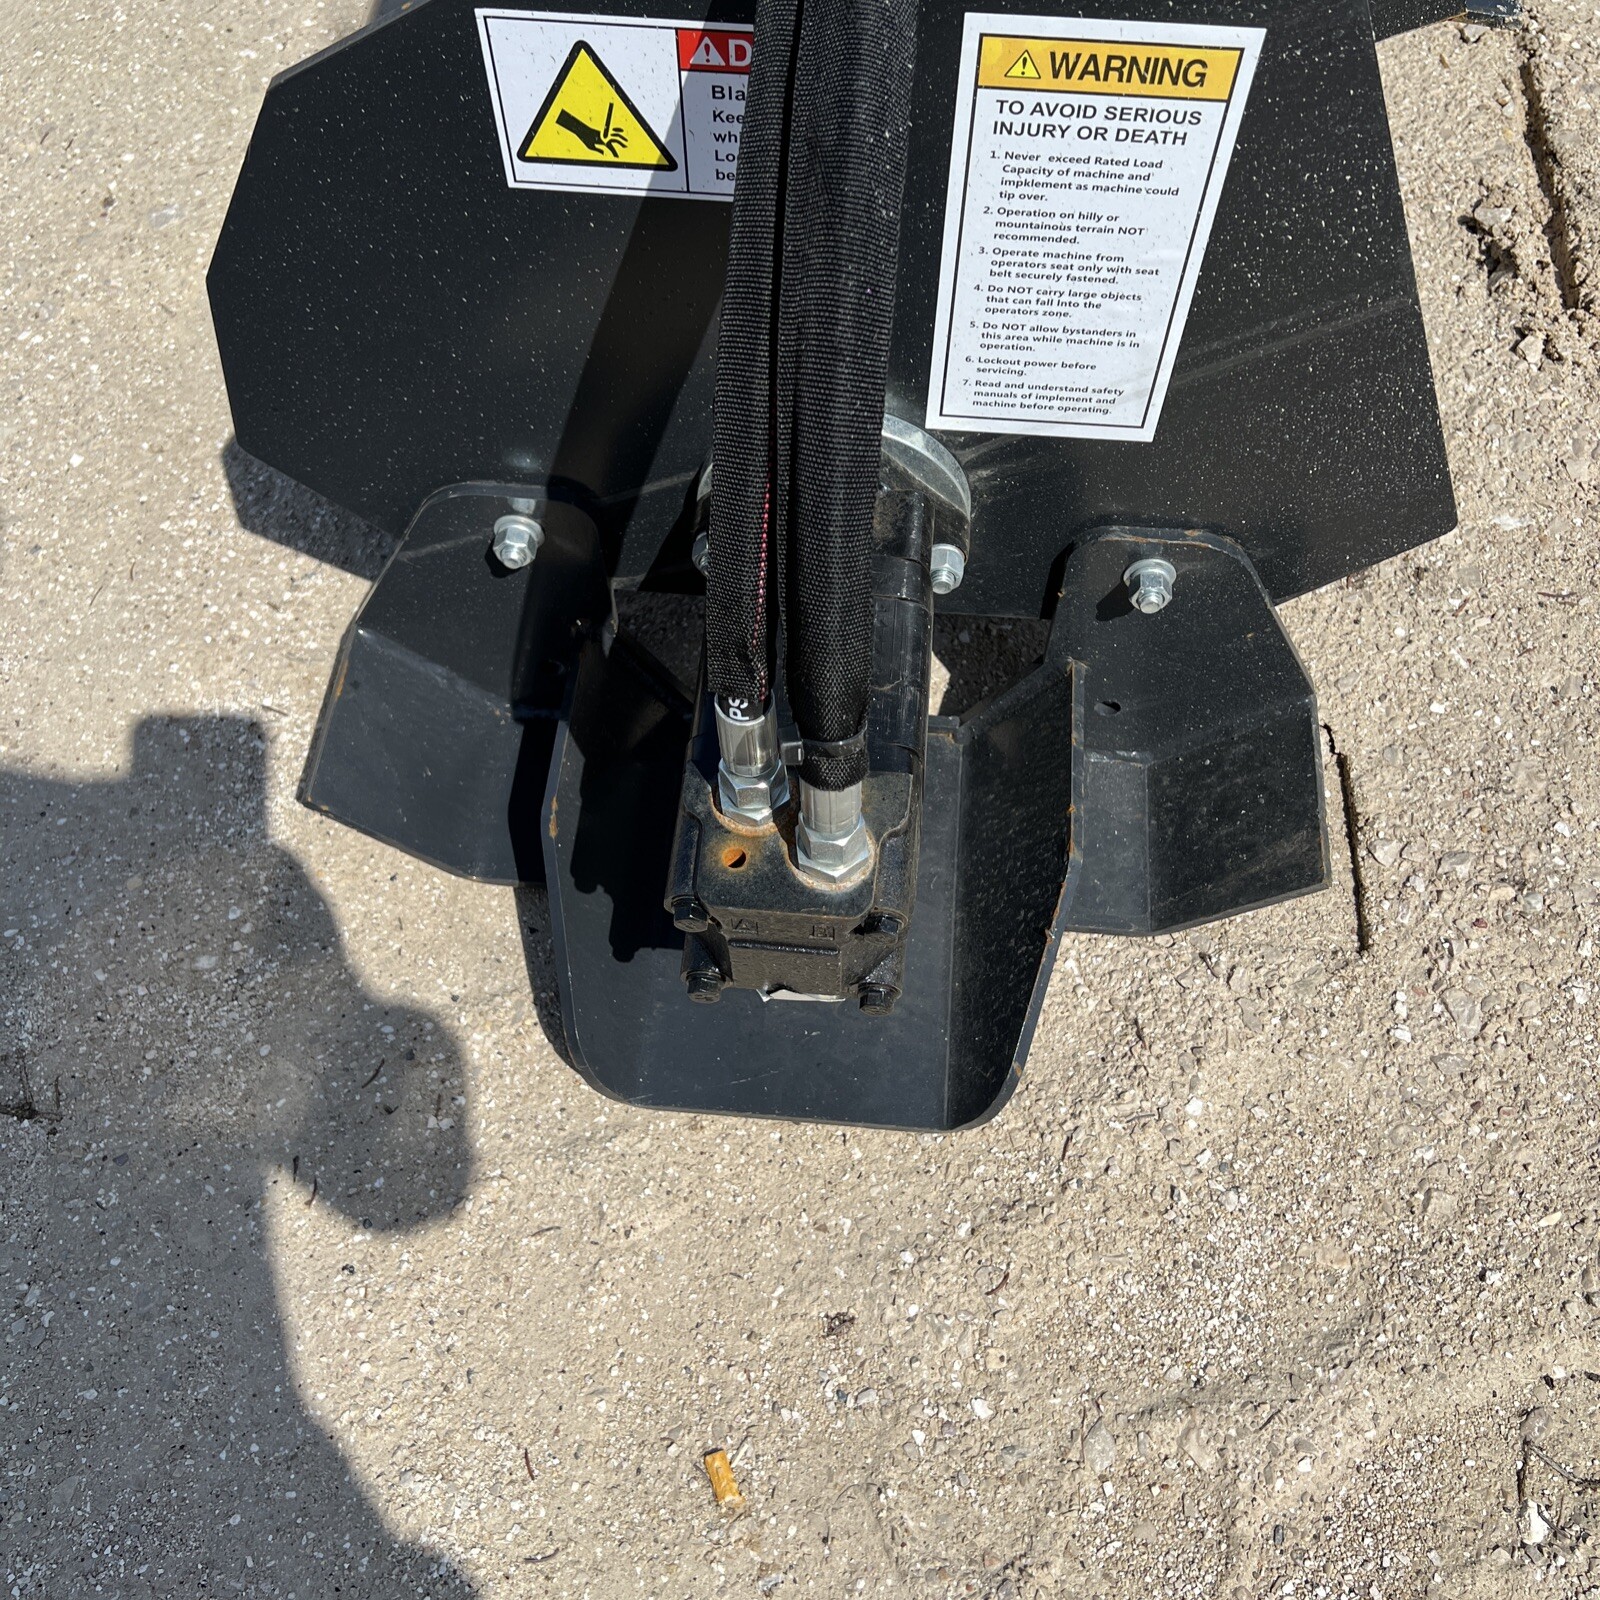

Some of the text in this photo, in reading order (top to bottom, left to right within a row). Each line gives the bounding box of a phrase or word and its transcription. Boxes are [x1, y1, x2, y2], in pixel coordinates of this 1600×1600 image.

[729, 39, 752, 66] D
[1050, 51, 1207, 87] WARNING
[712, 85, 745, 101] Bla
[713, 110, 744, 124] Kee
[996, 99, 1202, 125] TO AVOID SERIOUS
[713, 131, 738, 144] wh
[993, 121, 1187, 146] INJURY OR DEATH
[715, 149, 735, 162] Lo
[990, 151, 1162, 168] 1. Never exceed Rated Load
[716, 169, 735, 181] be
[1003, 164, 1150, 181] Capacity of machine and
[1000, 178, 1072, 190] impklement
[1092, 184, 1142, 194] machine
[1146, 187, 1179, 196] could
[999, 191, 1048, 201] tip over.
[983, 206, 993, 214] 2.
[997, 207, 1056, 218] Operation
[1060, 211, 1074, 219] on
[1078, 212, 1103, 222] hilly
[995, 220, 1144, 235] mountainous terrain NOT
[994, 233, 1080, 244] recommended.
[992, 247, 1039, 258] Operate
[1043, 250, 1092, 261] machine
[1096, 254, 1124, 263] from
[991, 260, 1047, 270] operators
[1077, 264, 1102, 273] only
[1106, 266, 1132, 274] with
[1015, 272, 1063, 282] securely
[1066, 274, 1118, 284] fastened.
[974, 284, 983, 292] 4.
[1007, 286, 1033, 294] NOT
[1036, 289, 1065, 297] carry
[1068, 290, 1097, 299] large
[1101, 292, 1142, 301] objects
[986, 296, 1009, 304] that
[1013, 297, 1031, 305] can
[1036, 298, 1053, 306] fall
[1084, 301, 1102, 309] the
[985, 306, 1072, 318] operators zone.
[1002, 323, 1026, 331] NOT
[1030, 325, 1059, 333] allow
[1063, 326, 1122, 338] bystanders
[980, 343, 1035, 351] operation.
[1066, 337, 1113, 346] machine
[978, 357, 1020, 366] Lockout
[1024, 360, 1058, 369] power
[1061, 362, 1096, 370] before
[976, 367, 1026, 376] servicing.
[974, 390, 1018, 399] manuals
[1021, 392, 1032, 400] of
[1035, 393, 1092, 403] implement
[1028, 383, 1088, 393] understand
[1092, 387, 1124, 396] safety
[972, 400, 1112, 415] machine before operating.
[728, 696, 750, 721] PS
